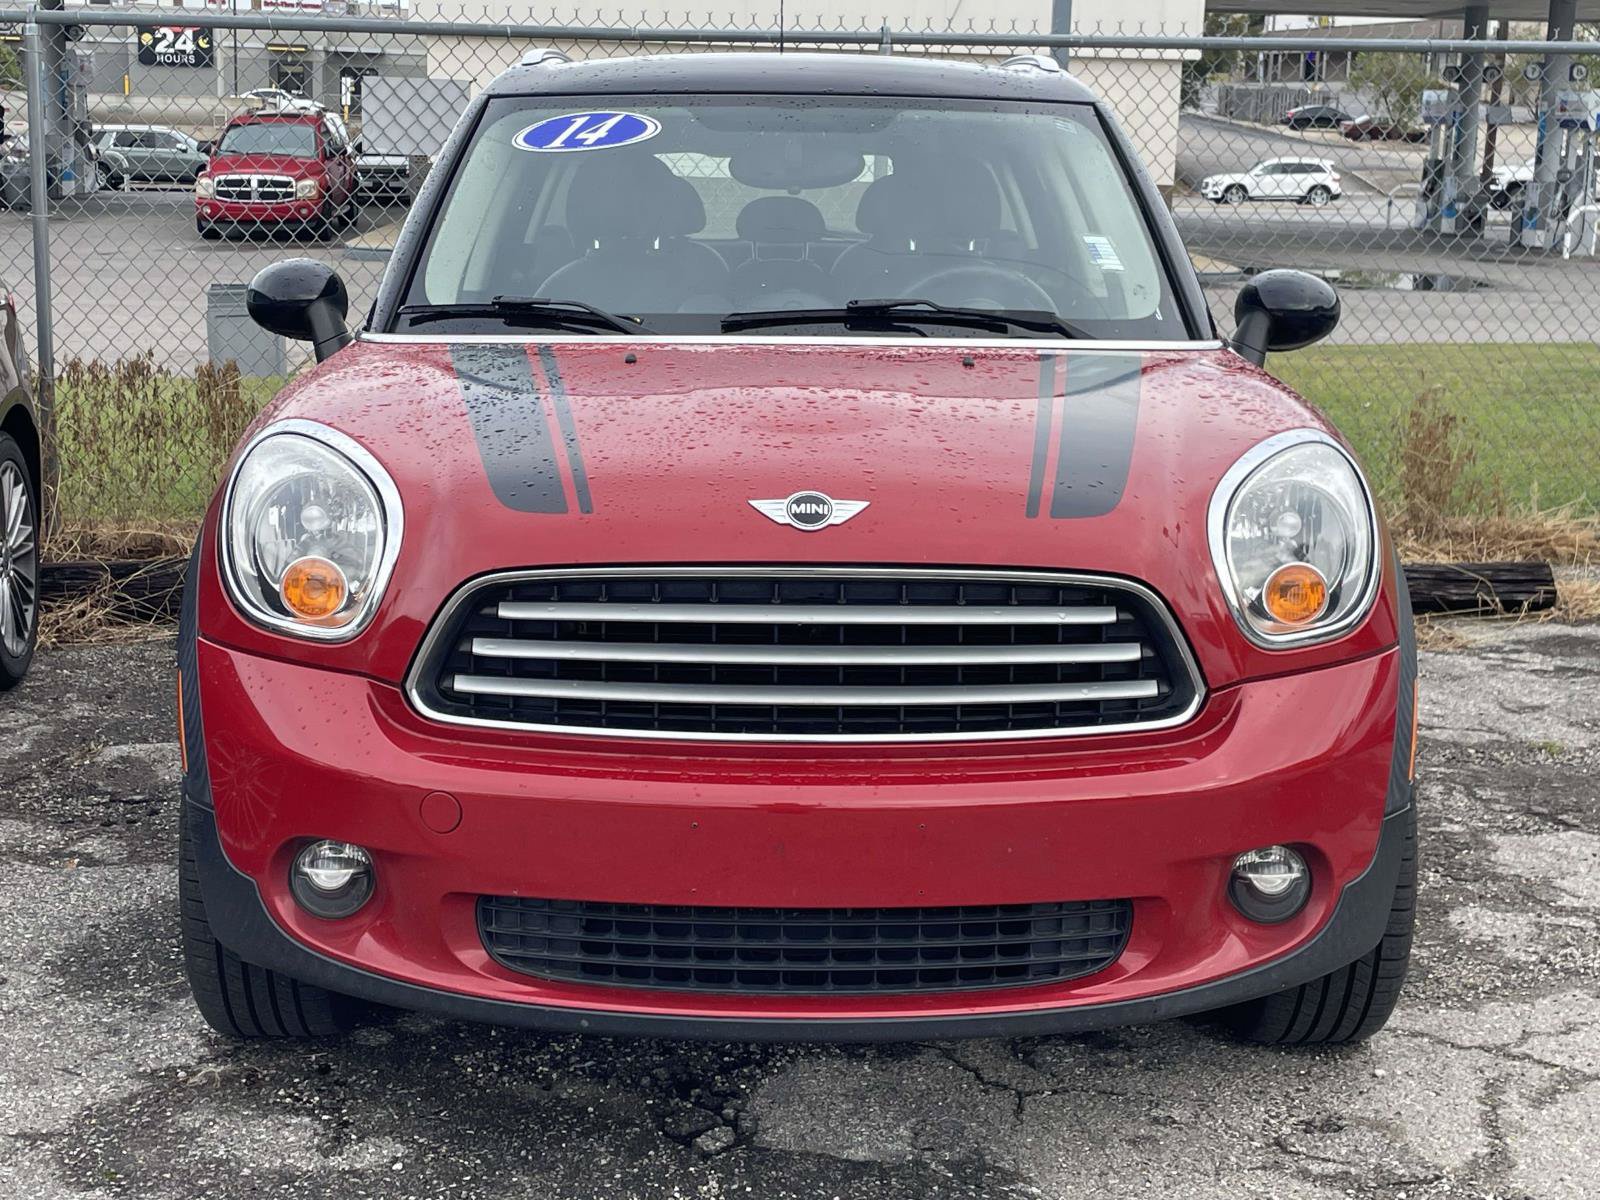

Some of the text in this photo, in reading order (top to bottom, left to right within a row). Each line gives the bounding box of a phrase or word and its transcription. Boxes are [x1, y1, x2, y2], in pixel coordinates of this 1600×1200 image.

[154, 26, 196, 54] 24
[156, 54, 195, 64] HOURS
[542, 114, 626, 148] 14
[790, 503, 829, 515] MINI
